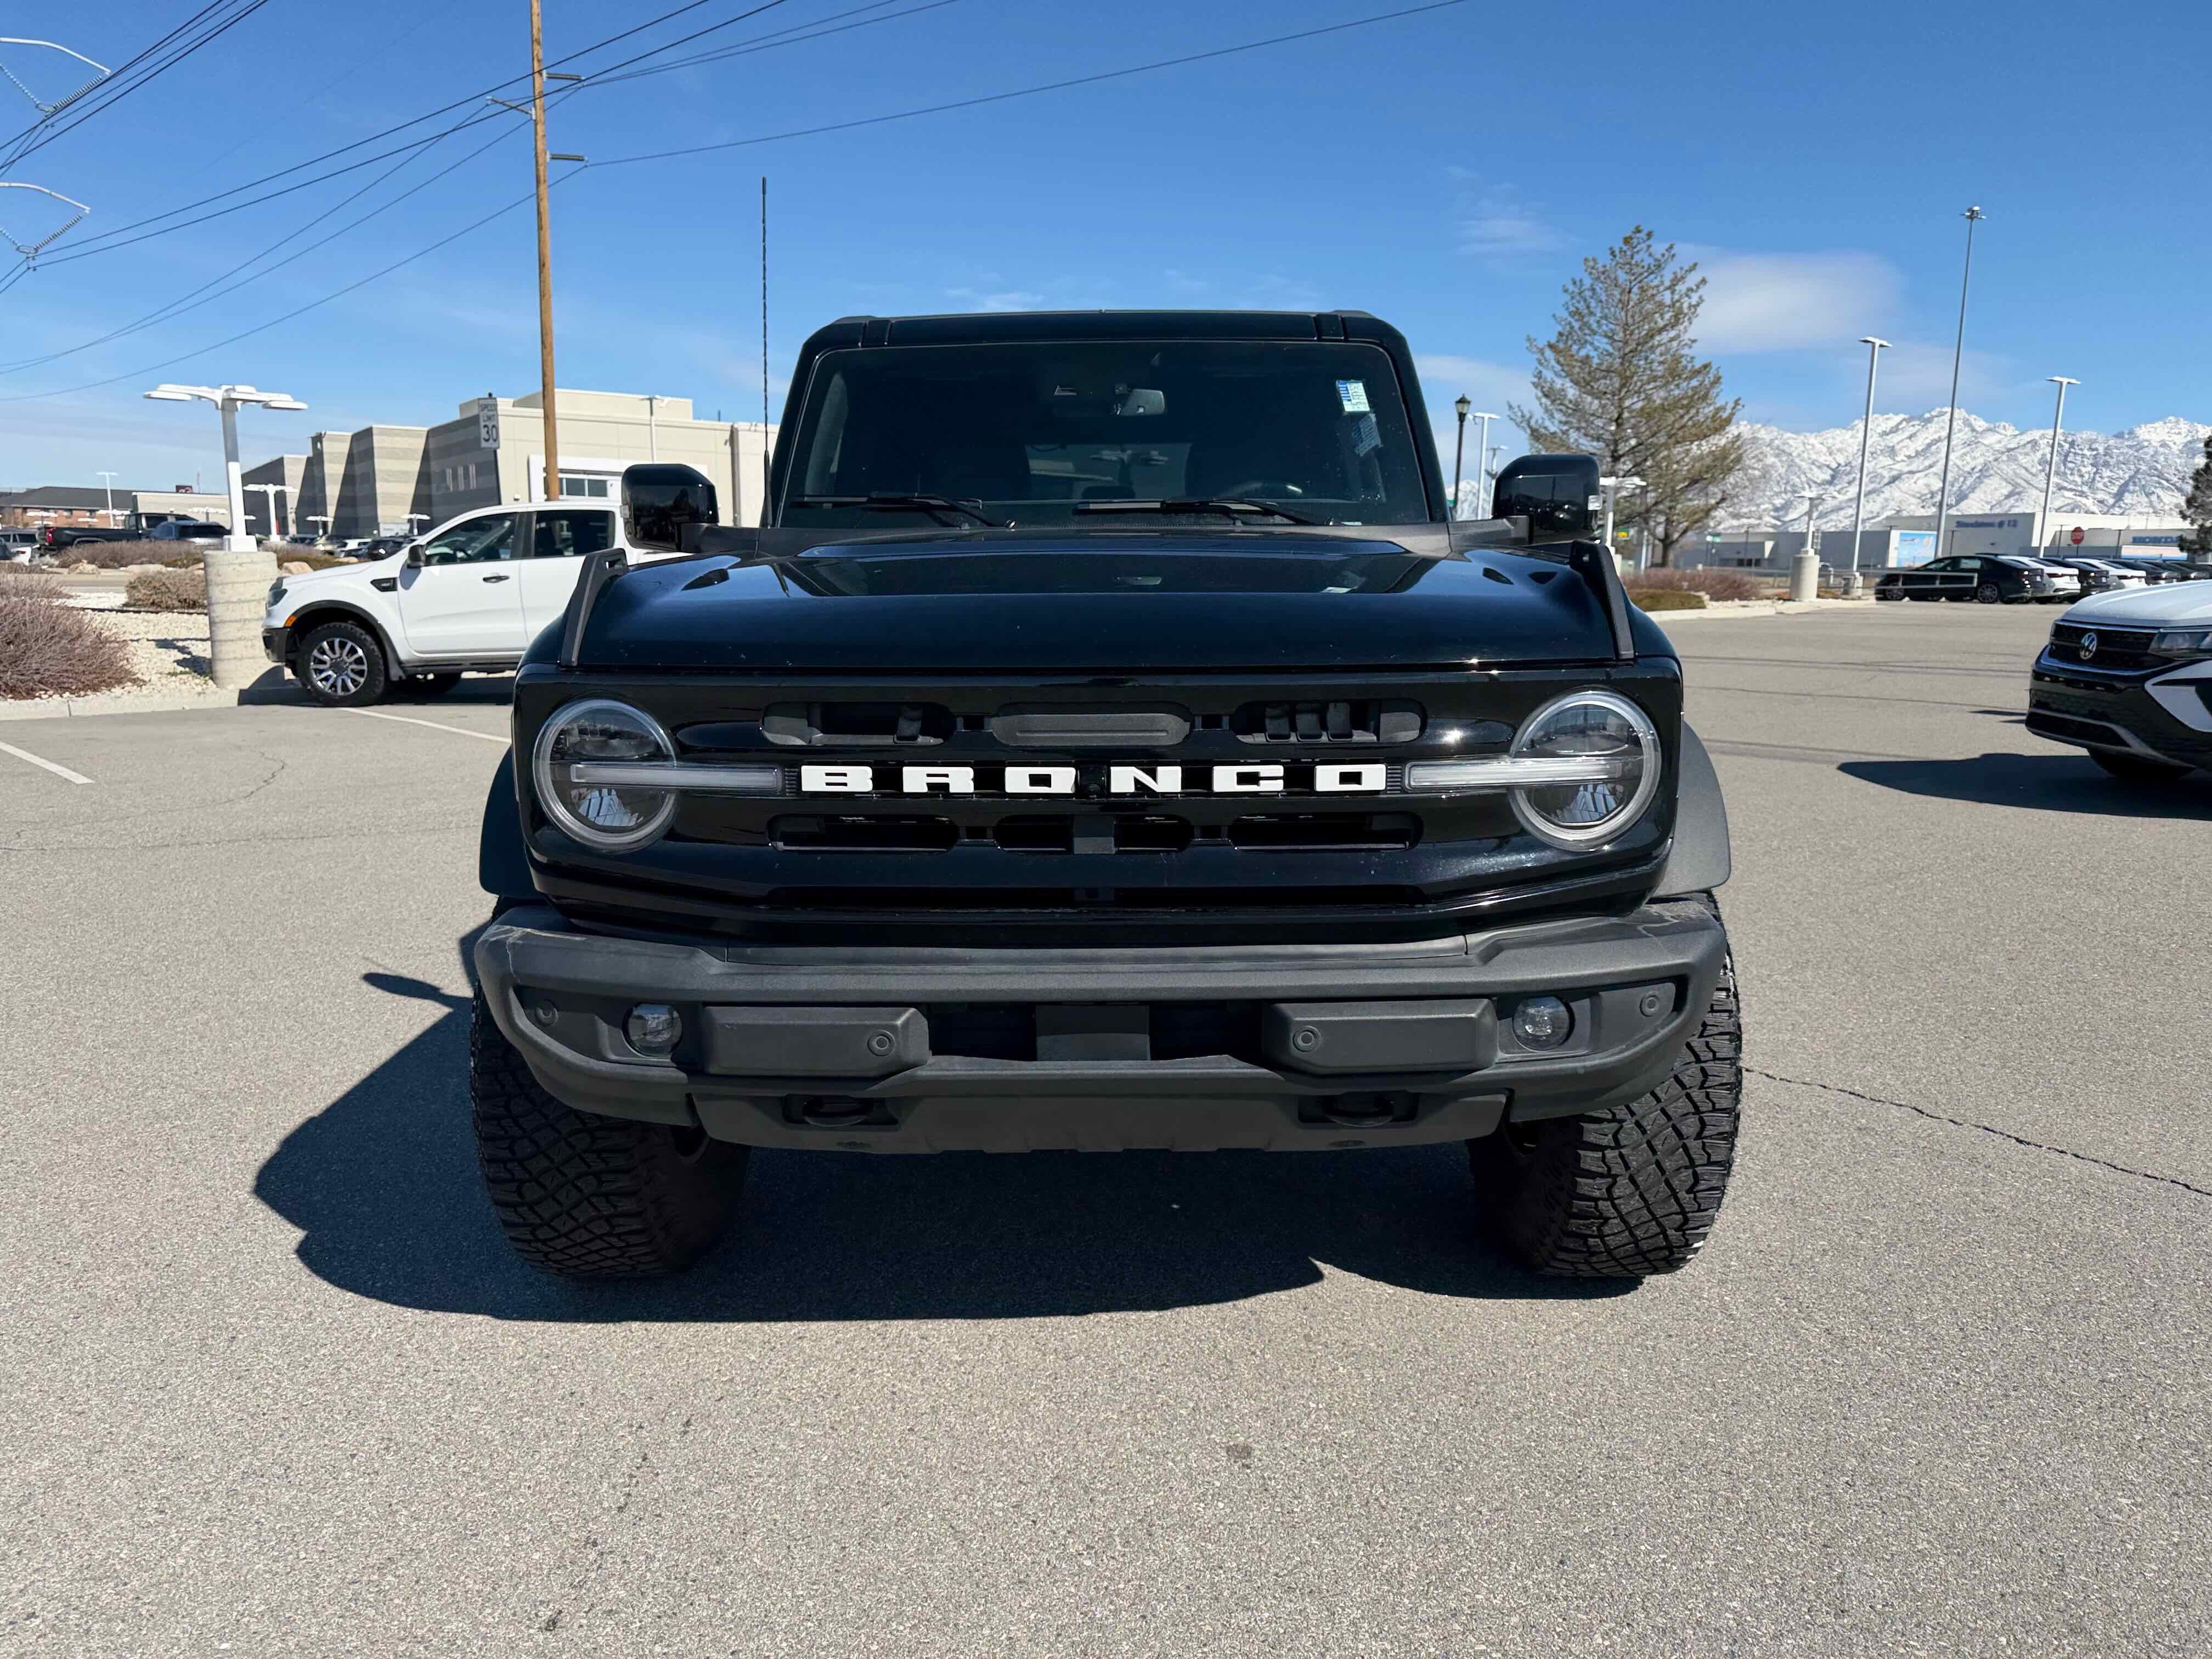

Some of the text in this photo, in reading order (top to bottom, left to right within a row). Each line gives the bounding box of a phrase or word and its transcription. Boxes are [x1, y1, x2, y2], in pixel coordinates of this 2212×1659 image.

[479, 403, 496, 411] SPEED
[483, 414, 496, 423] LIMIT
[483, 424, 497, 442] 30
[801, 764, 1386, 793] BRONCO
